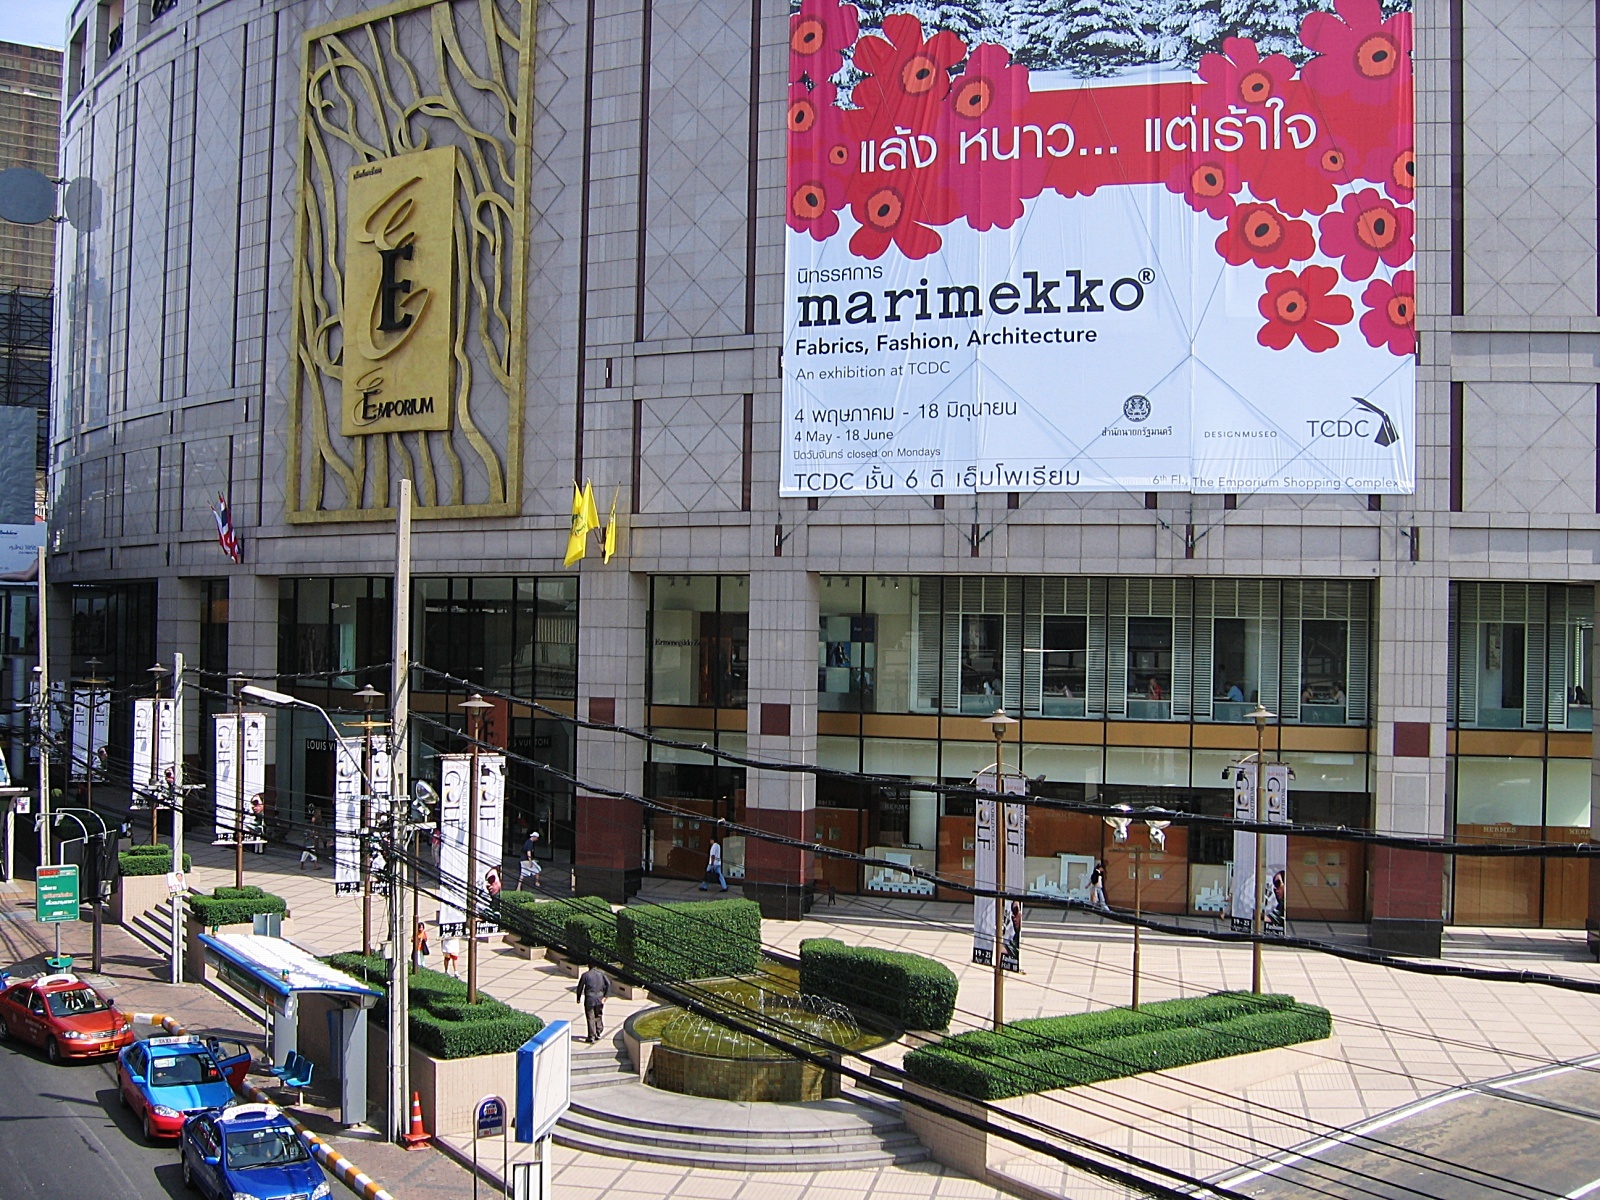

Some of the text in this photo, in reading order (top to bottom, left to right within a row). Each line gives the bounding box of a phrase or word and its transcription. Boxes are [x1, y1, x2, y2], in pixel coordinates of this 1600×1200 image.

[859, 96, 1318, 174] แล้ง หนาว... แต่เร้าใจ
[797, 266, 883, 284] นิทรรศการ
[795, 326, 1098, 356] Fabrics, Fashion, Architecture
[795, 360, 951, 381] An exhibition at TCDC
[794, 408, 804, 424] 4
[812, 405, 895, 428] พฤษภาคม
[918, 403, 939, 419] 18
[946, 400, 1018, 422] มิถุนายน
[794, 431, 802, 443] 4
[806, 430, 833, 445] May
[845, 429, 860, 442] 18
[863, 429, 895, 442] June
[1306, 420, 1370, 438] TCDC
[846, 448, 878, 460] closed
[881, 450, 894, 459] on
[896, 447, 942, 459] Mondays
[794, 472, 855, 492] TCDC
[865, 465, 893, 490] ชั้น
[905, 468, 918, 490] 6
[956, 461, 1081, 489] เอ็มโพเรียม
[1152, 475, 1167, 486] 6th
[1192, 477, 1215, 488] The
[1218, 477, 1279, 490] Emporium
[1283, 477, 1341, 491] Shopping
[1344, 476, 1400, 490] Complex
[306, 740, 327, 751] LOUIS
[444, 770, 461, 827] GOLF
[480, 767, 497, 828] GOLF
